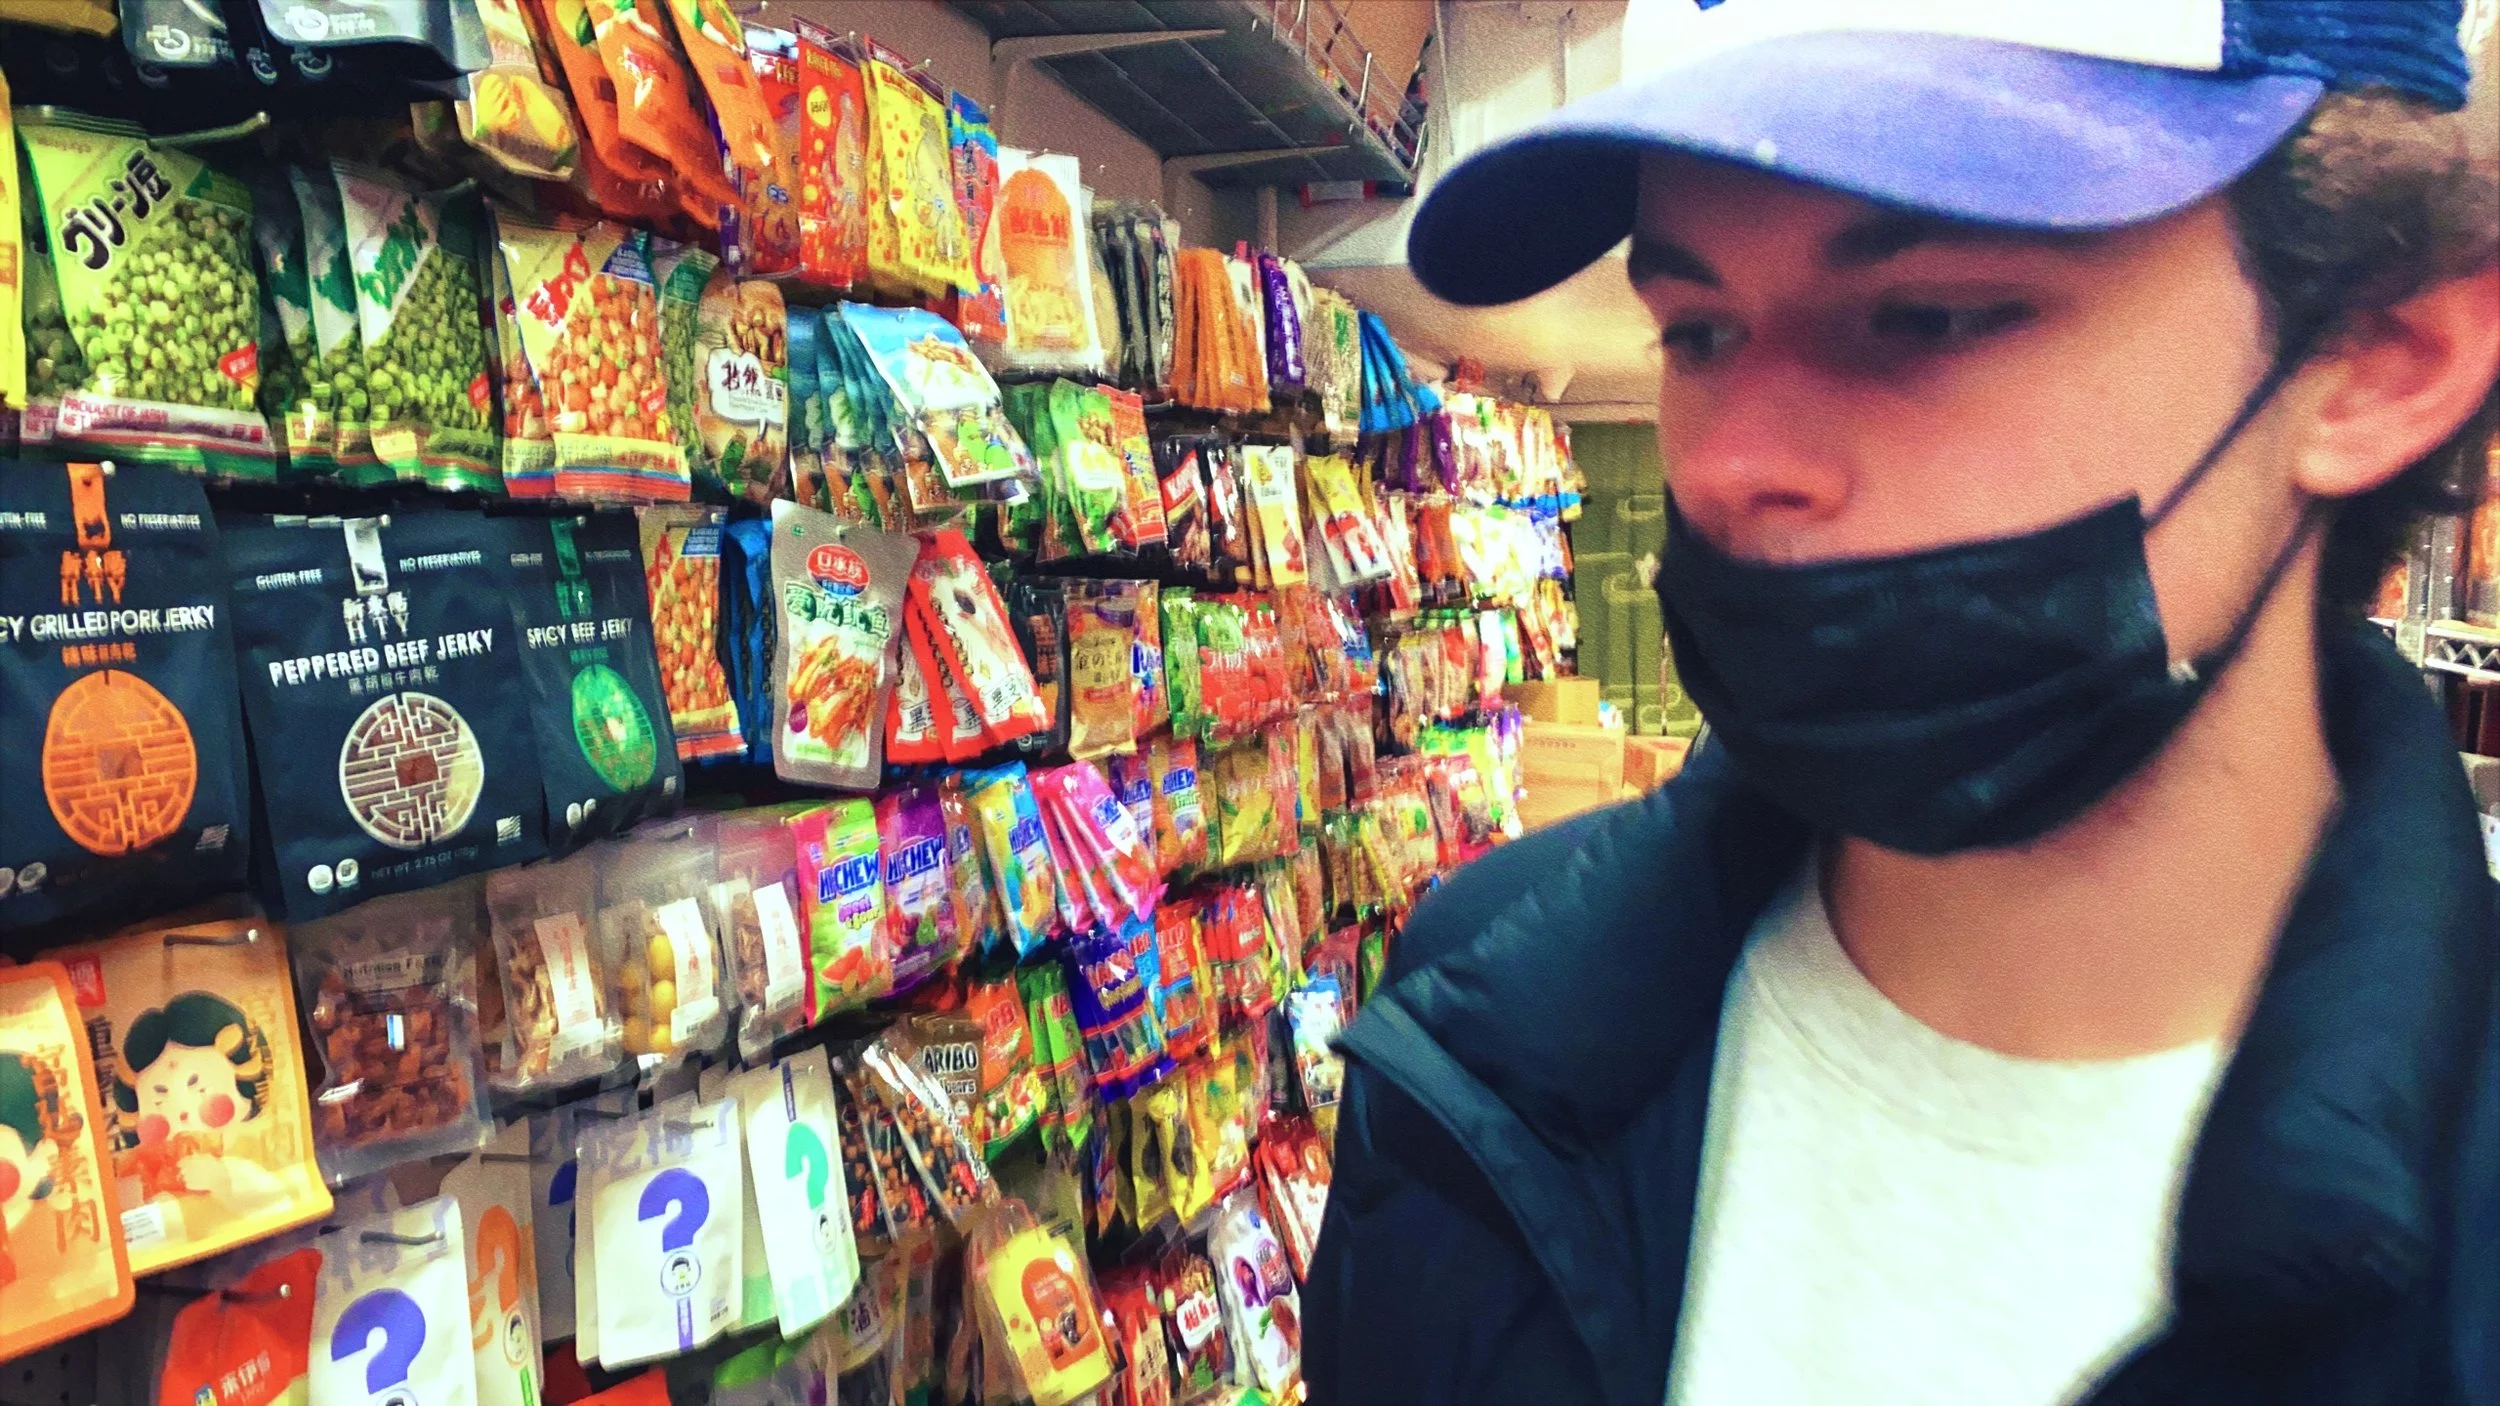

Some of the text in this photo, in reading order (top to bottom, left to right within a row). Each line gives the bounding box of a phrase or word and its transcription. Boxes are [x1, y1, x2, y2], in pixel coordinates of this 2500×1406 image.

[121, 514, 136, 529] NO
[399, 550, 482, 573] NO PRESERVATIVES
[256, 569, 322, 590] GLUTEN-FREE
[30, 611, 108, 641] GRILLED
[109, 609, 162, 635] PORK
[163, 605, 214, 632] JERKY
[526, 618, 633, 650] SPICY BEEF JERKY
[268, 628, 493, 688] PEPPERED BEEF JERKY
[922, 1042, 979, 1075] ARIBO
